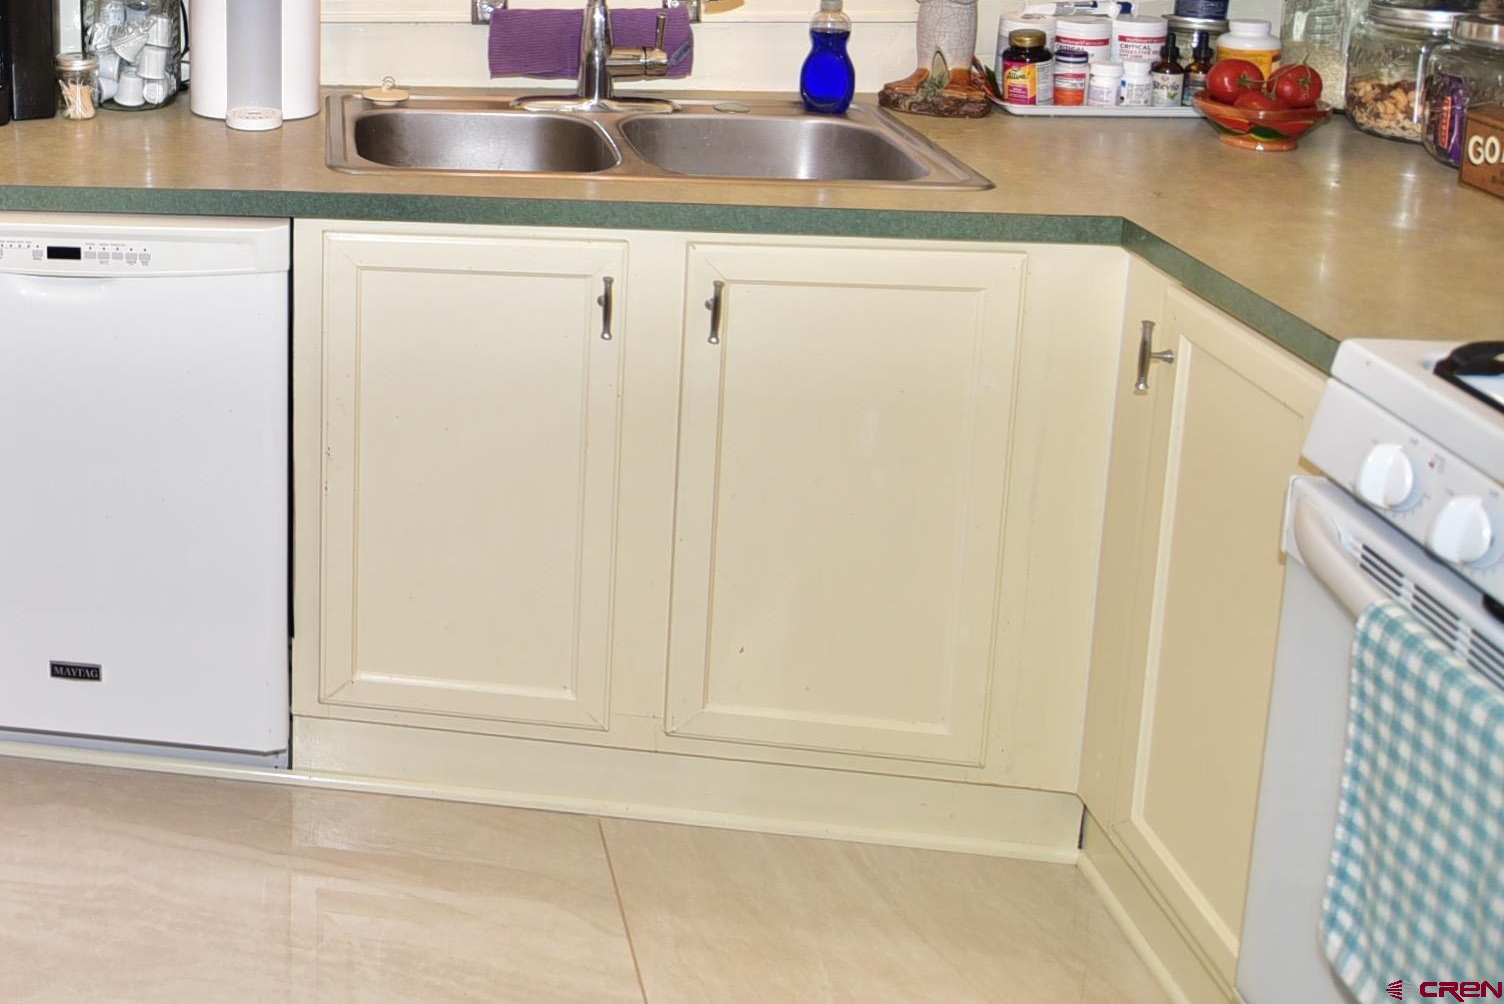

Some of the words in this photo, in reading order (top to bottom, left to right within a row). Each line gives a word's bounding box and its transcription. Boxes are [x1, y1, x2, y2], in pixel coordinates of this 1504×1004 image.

[1119, 43, 1152, 51] CRITICAL
[1468, 134, 1504, 165] GO
[53, 666, 98, 679] MAYTAG
